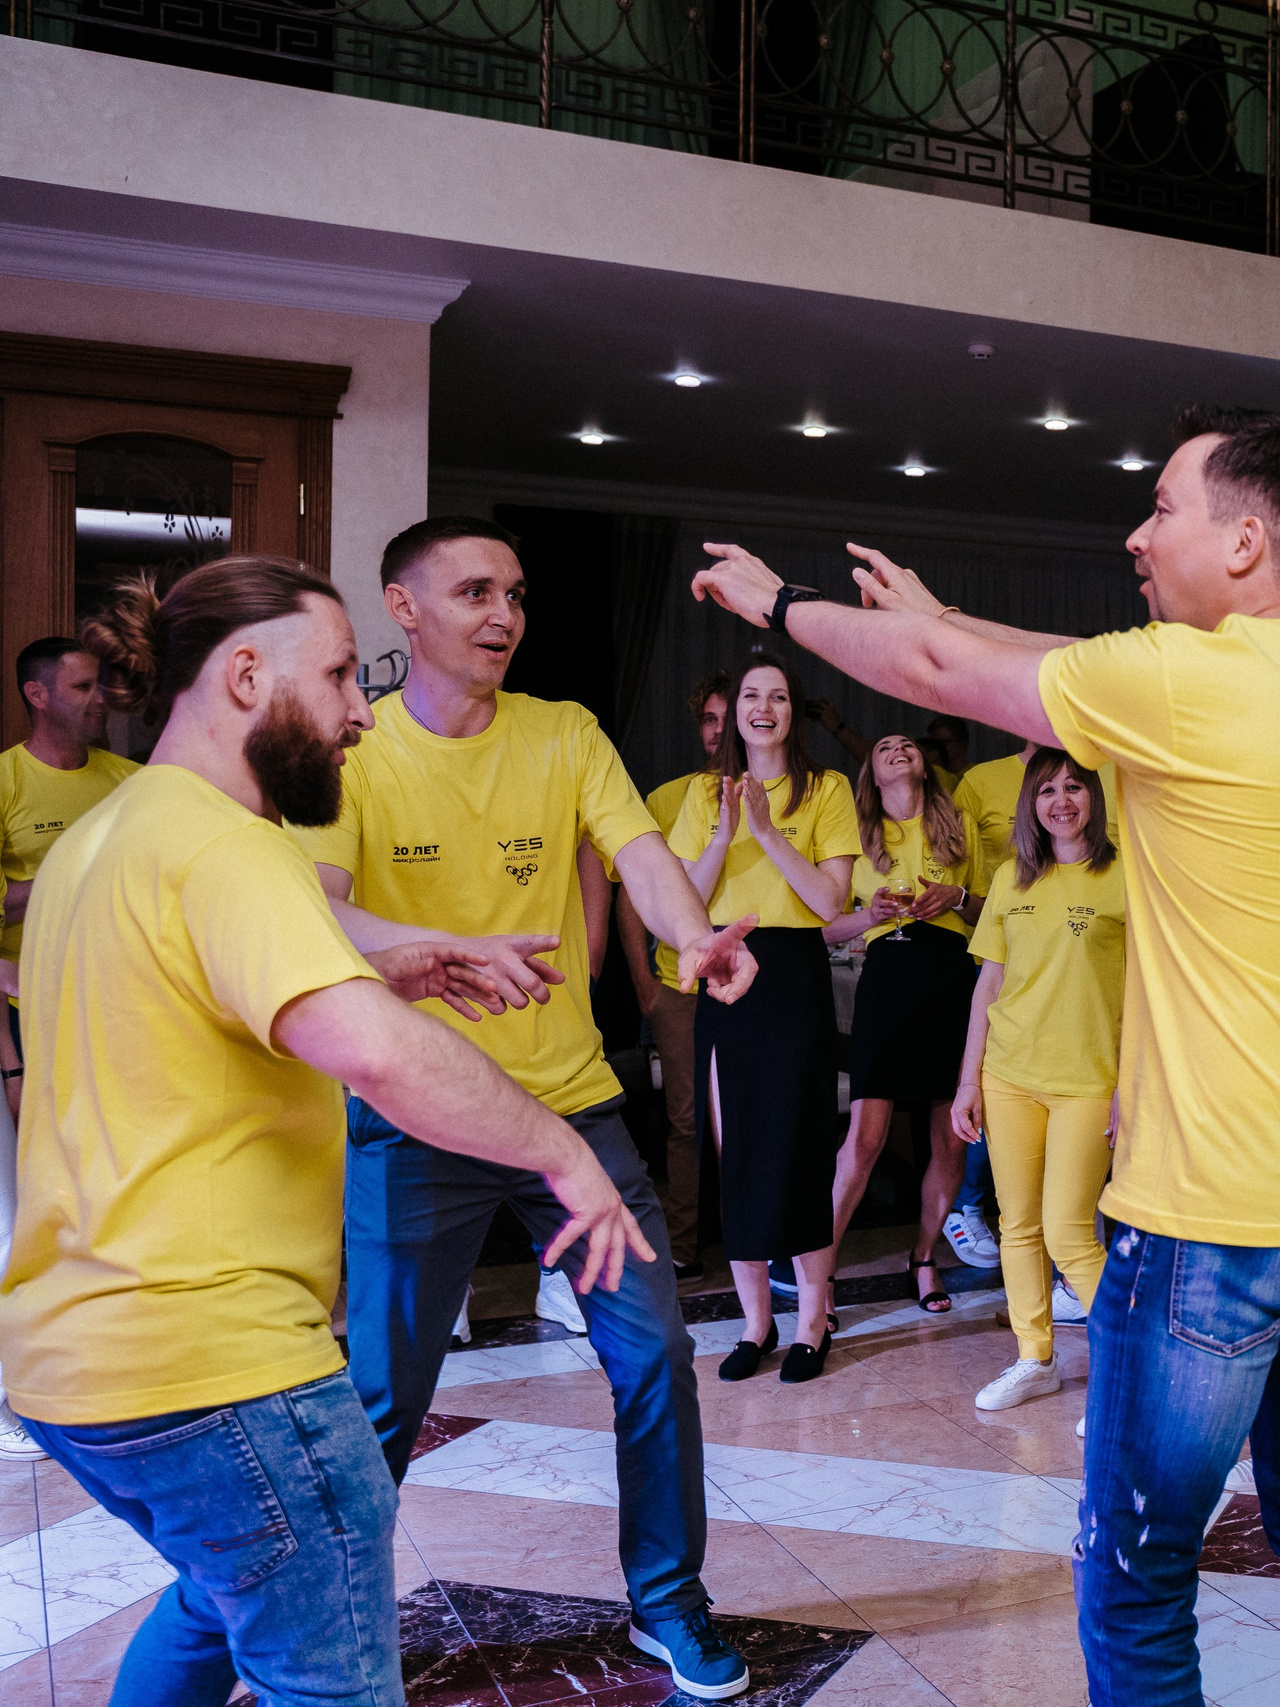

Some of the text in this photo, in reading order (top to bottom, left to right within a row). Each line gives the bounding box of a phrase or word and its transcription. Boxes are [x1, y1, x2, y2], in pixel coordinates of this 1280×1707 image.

[778, 827, 797, 835] ES
[497, 836, 543, 852] YES
[393, 845, 439, 855] 20 ЛЕТ
[392, 856, 441, 864] микролайн
[504, 853, 538, 861] HOLDING
[1067, 906, 1095, 916] YES
